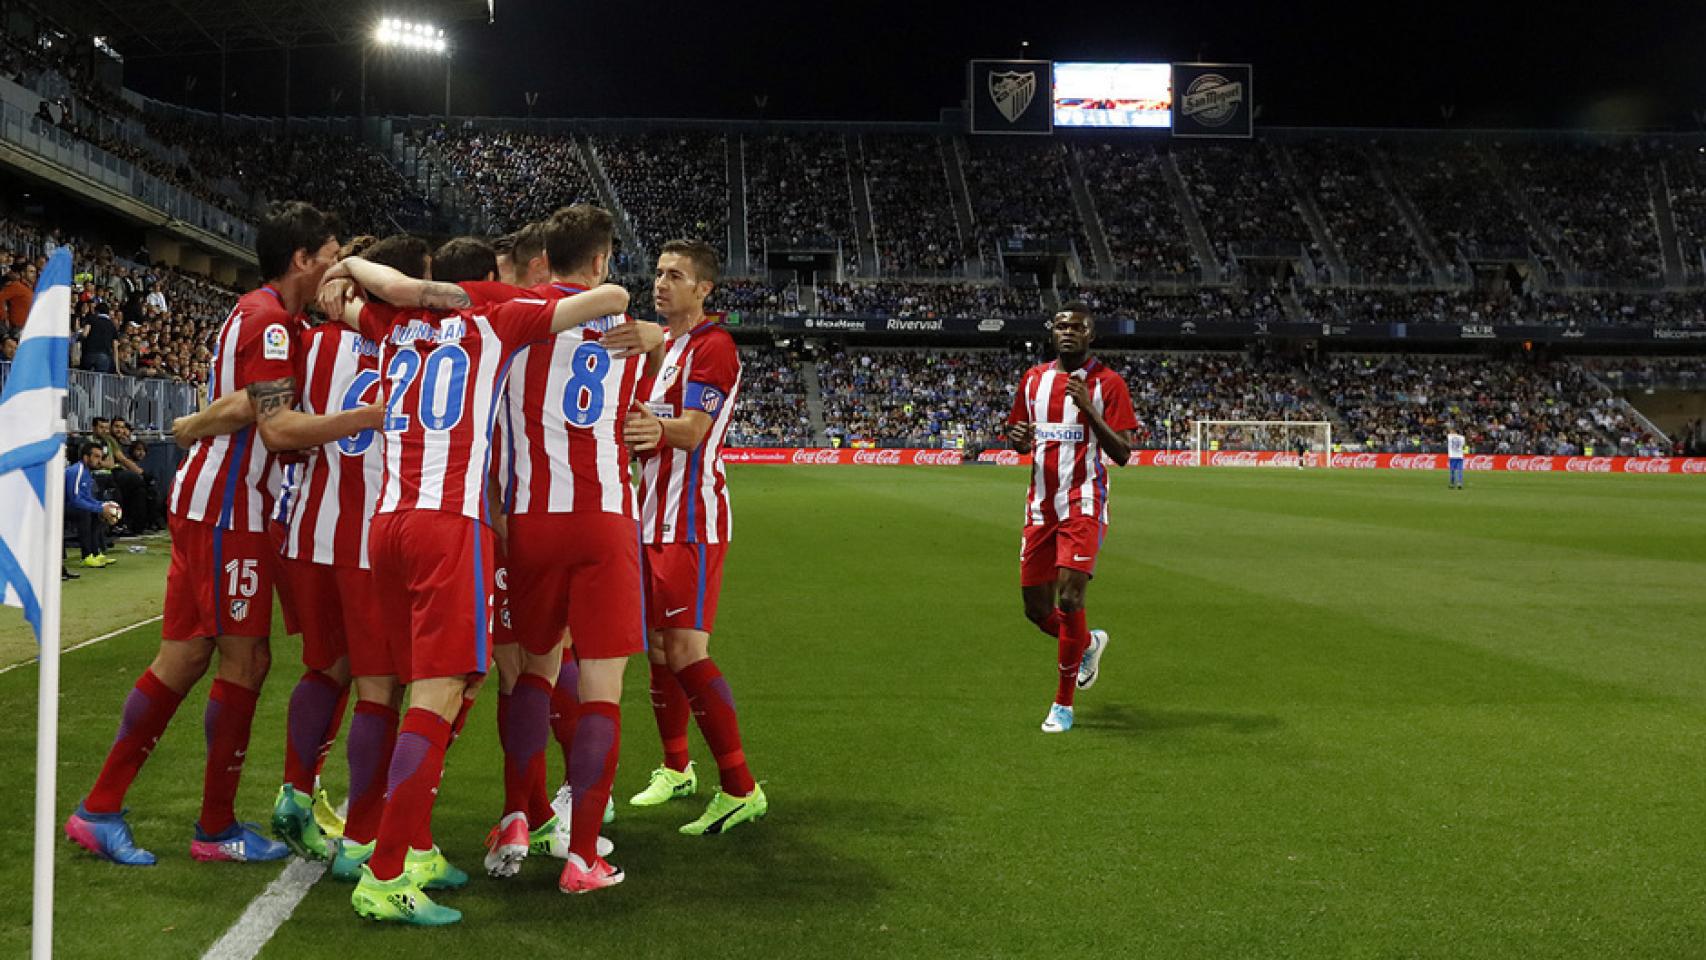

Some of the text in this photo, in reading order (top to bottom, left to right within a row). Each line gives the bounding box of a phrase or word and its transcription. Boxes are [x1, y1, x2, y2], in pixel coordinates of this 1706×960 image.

[887, 319, 942, 330] Rivervial
[384, 343, 470, 432] 20
[562, 341, 611, 428] 8
[225, 558, 258, 597] 15
